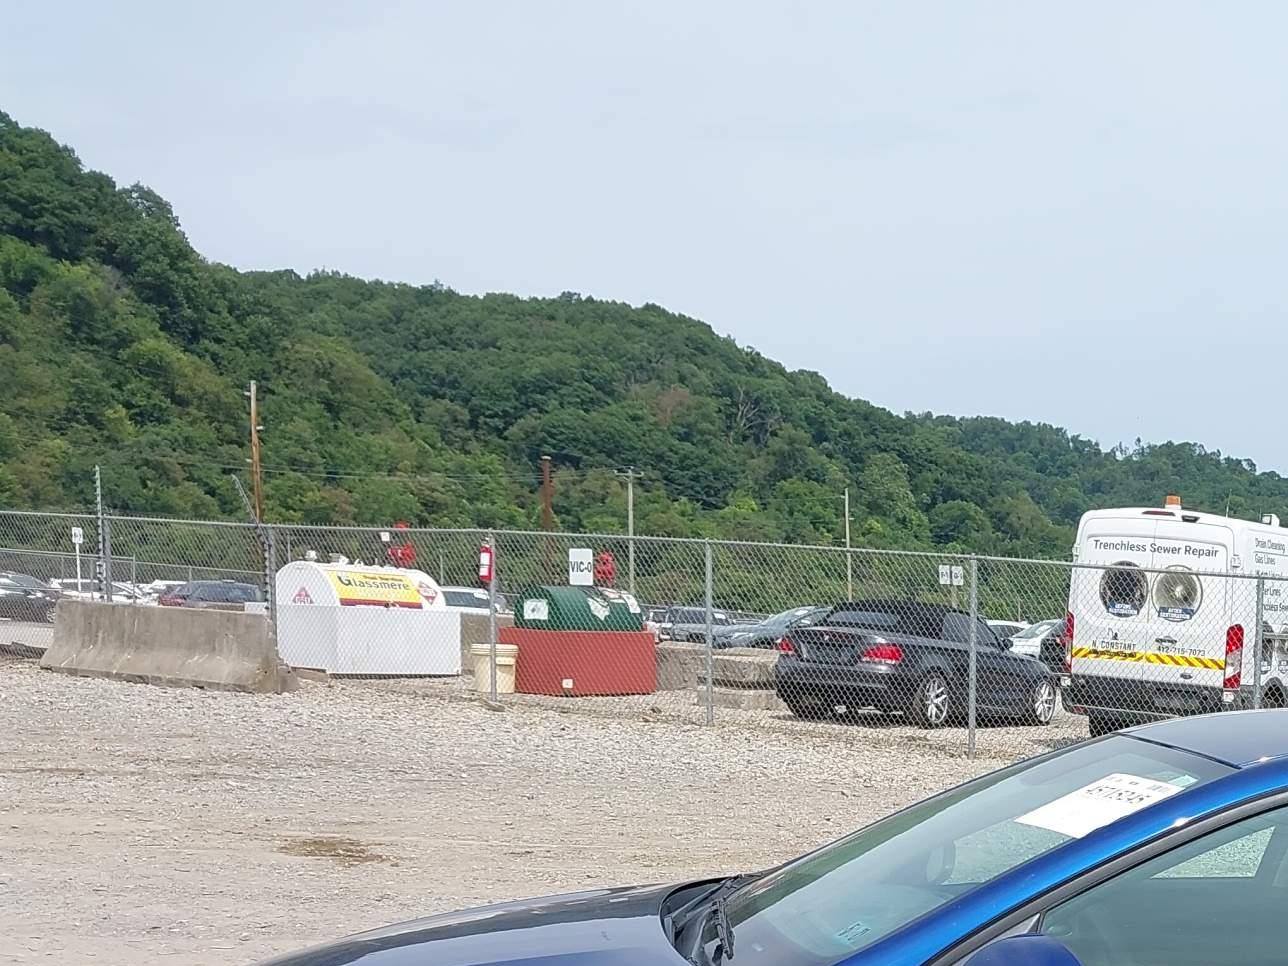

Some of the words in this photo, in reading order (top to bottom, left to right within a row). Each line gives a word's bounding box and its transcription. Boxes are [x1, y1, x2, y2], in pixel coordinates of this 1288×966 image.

[1093, 539, 1147, 553] Trenchless
[1149, 543, 1182, 555] Sewer
[1184, 545, 1219, 559] Repair
[337, 575, 410, 591] Glassmere
[1100, 640, 1137, 651] CONSTANT
